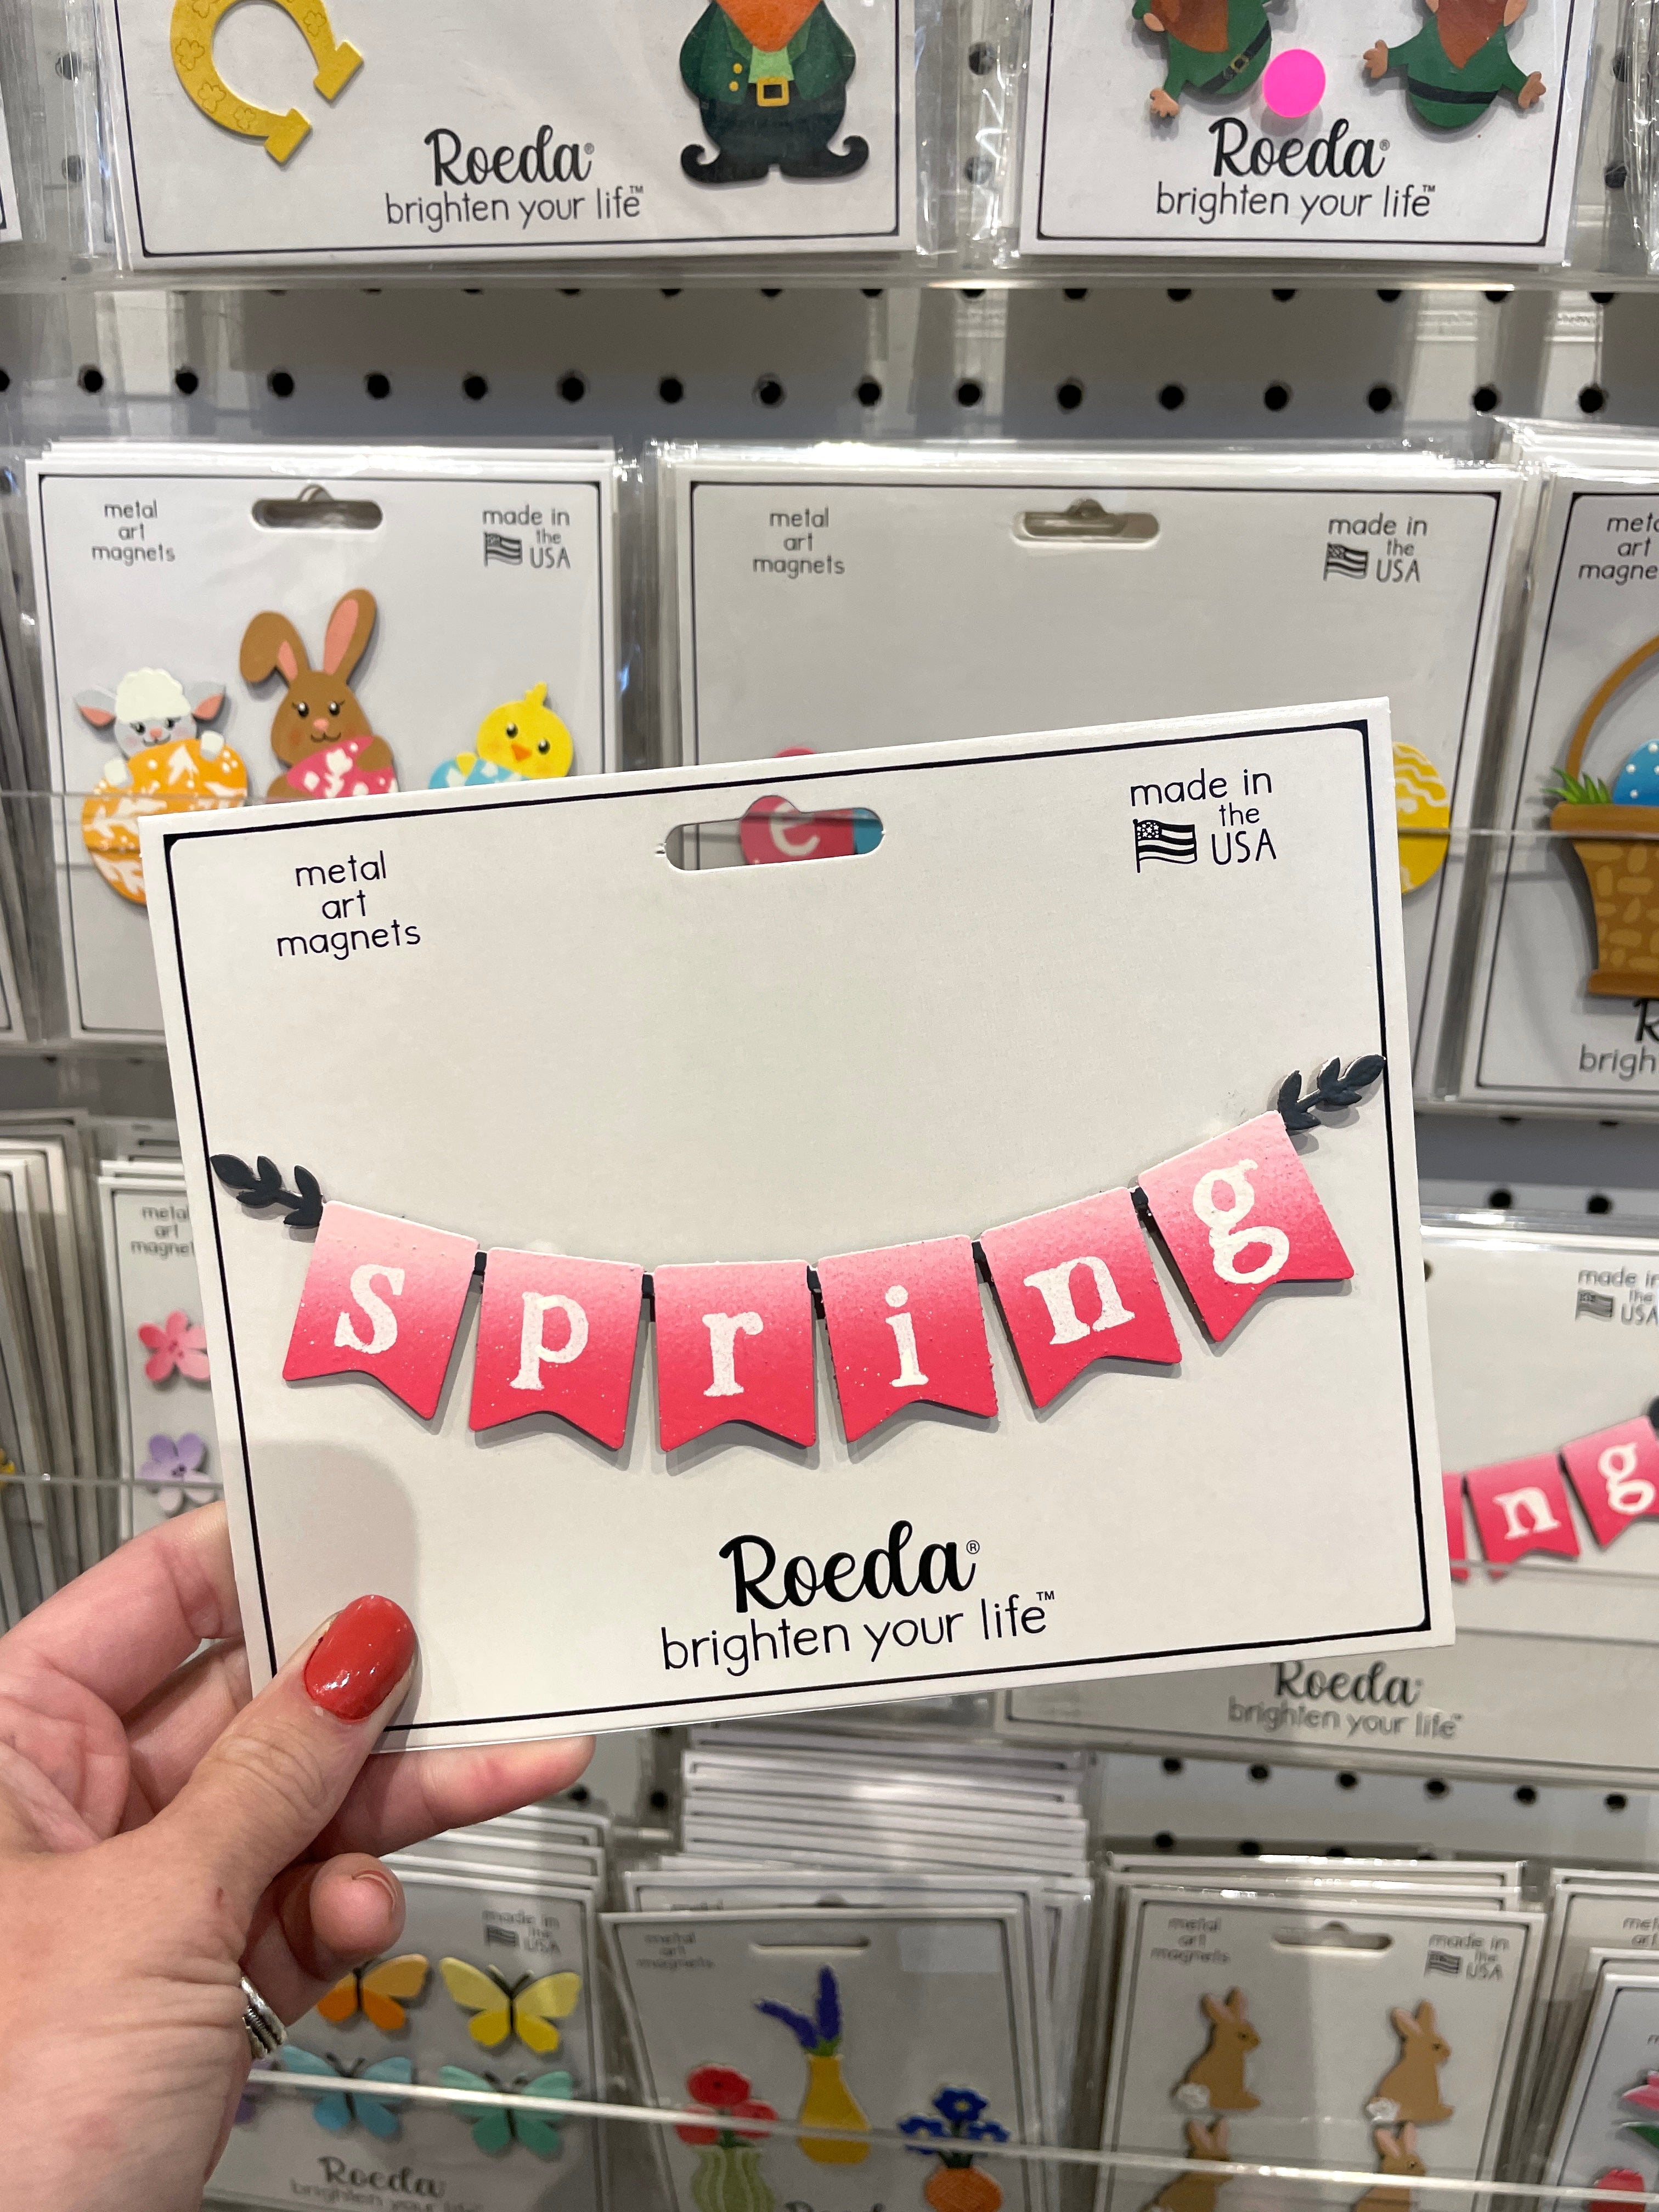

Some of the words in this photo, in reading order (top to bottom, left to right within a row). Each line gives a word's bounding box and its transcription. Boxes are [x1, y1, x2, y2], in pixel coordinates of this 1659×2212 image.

[386, 190, 509, 233] brighten
[519, 198, 585, 229] your
[1157, 181, 1288, 224] brighten
[1300, 194, 1372, 224] your
[104, 498, 157, 518] metal
[482, 503, 543, 526] made
[551, 508, 570, 526] in
[770, 506, 829, 528] metal
[118, 522, 144, 540] art
[536, 527, 561, 544] the
[1328, 511, 1396, 535] made
[1407, 516, 1427, 536] in
[783, 532, 812, 551] art
[1386, 538, 1414, 556] the
[1618, 537, 1651, 557] art
[91, 542, 176, 567] magnets
[530, 546, 571, 569] USA
[753, 554, 845, 579] magnets
[1376, 558, 1420, 583] USA
[1578, 565, 1658, 586] magne
[1131, 768, 1227, 806] made
[1243, 769, 1272, 795] in
[1219, 802, 1260, 826] the
[1212, 828, 1277, 865] USA
[296, 850, 386, 887] metal
[322, 890, 365, 919] art
[277, 919, 421, 960] magnets
[1579, 1043, 1659, 1081] brigh
[131, 1241, 195, 1261] magnet
[1578, 1266, 1637, 1288] made
[1621, 1304, 1658, 1325] USA
[662, 1618, 850, 1676] brighten
[864, 1613, 964, 1662] your
[1228, 1695, 1340, 1733] brighten
[1347, 1714, 1409, 1737] your
